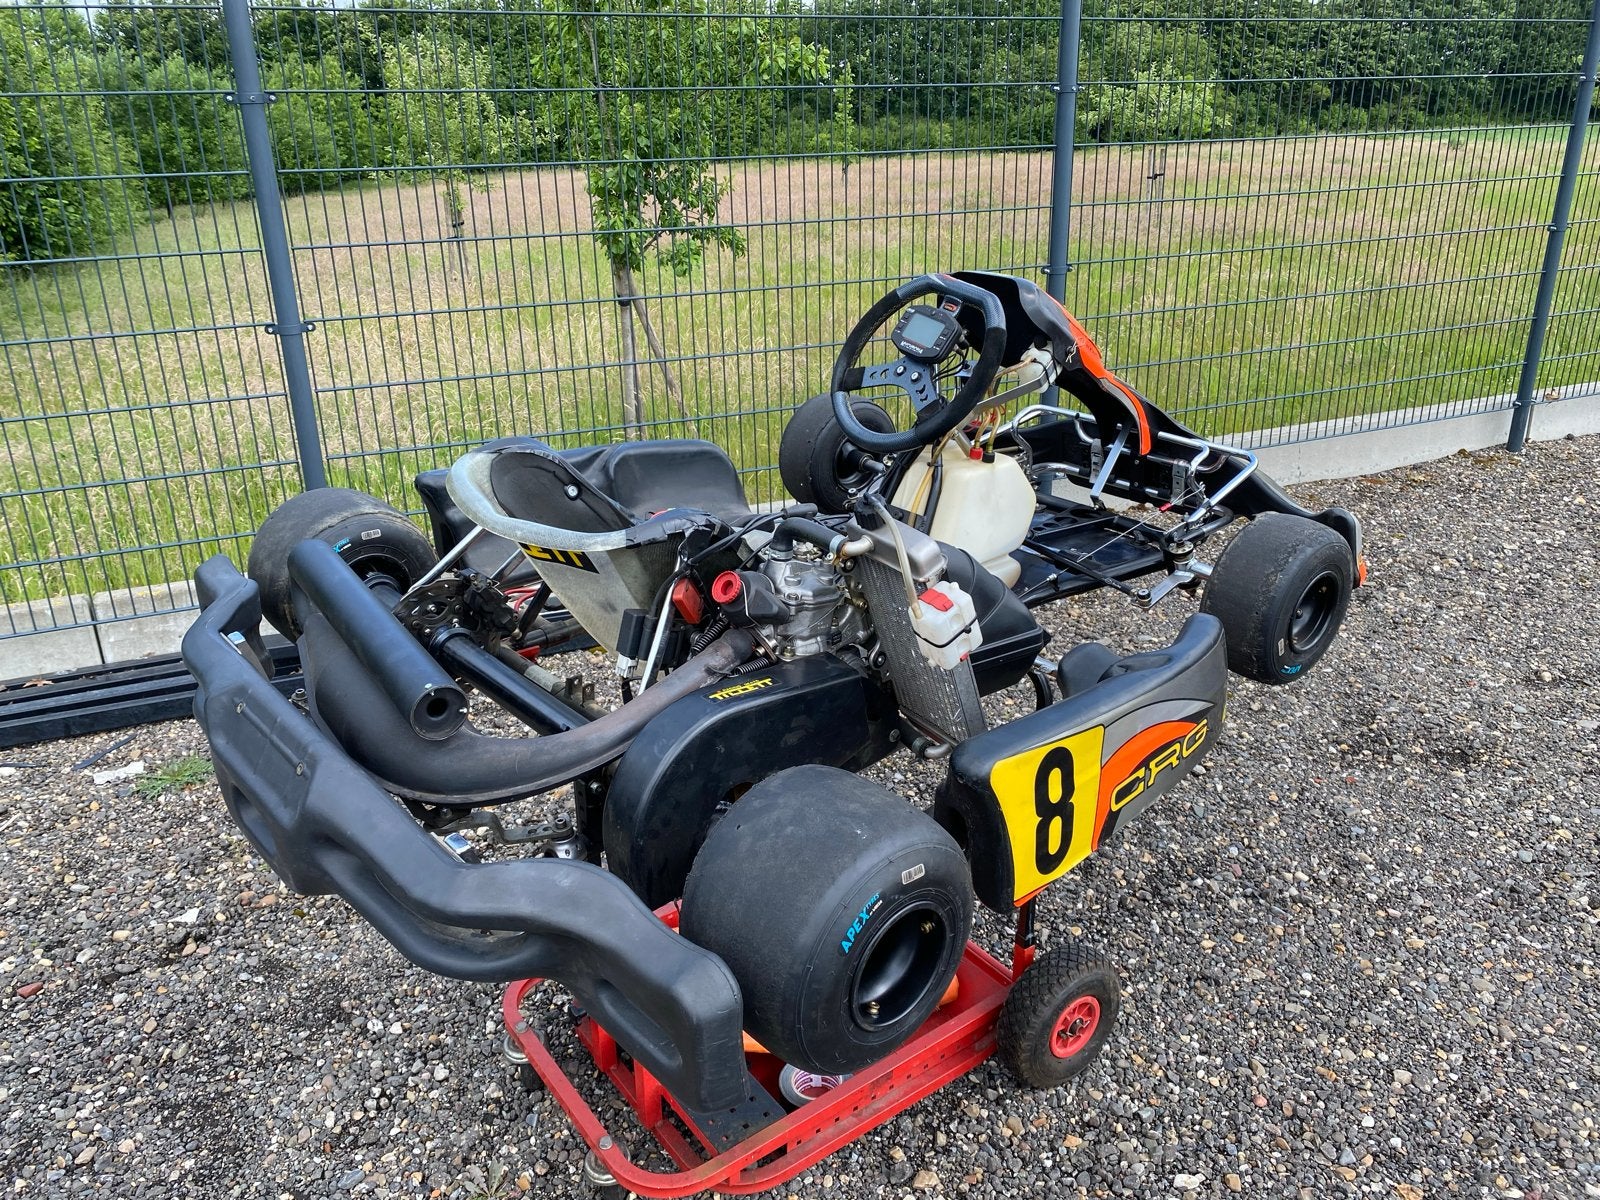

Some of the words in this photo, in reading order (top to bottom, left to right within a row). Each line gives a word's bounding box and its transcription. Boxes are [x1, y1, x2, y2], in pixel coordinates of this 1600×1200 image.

[1034, 746, 1075, 875] 8
[1110, 718, 1208, 812] CRG
[841, 906, 870, 953] APEX
